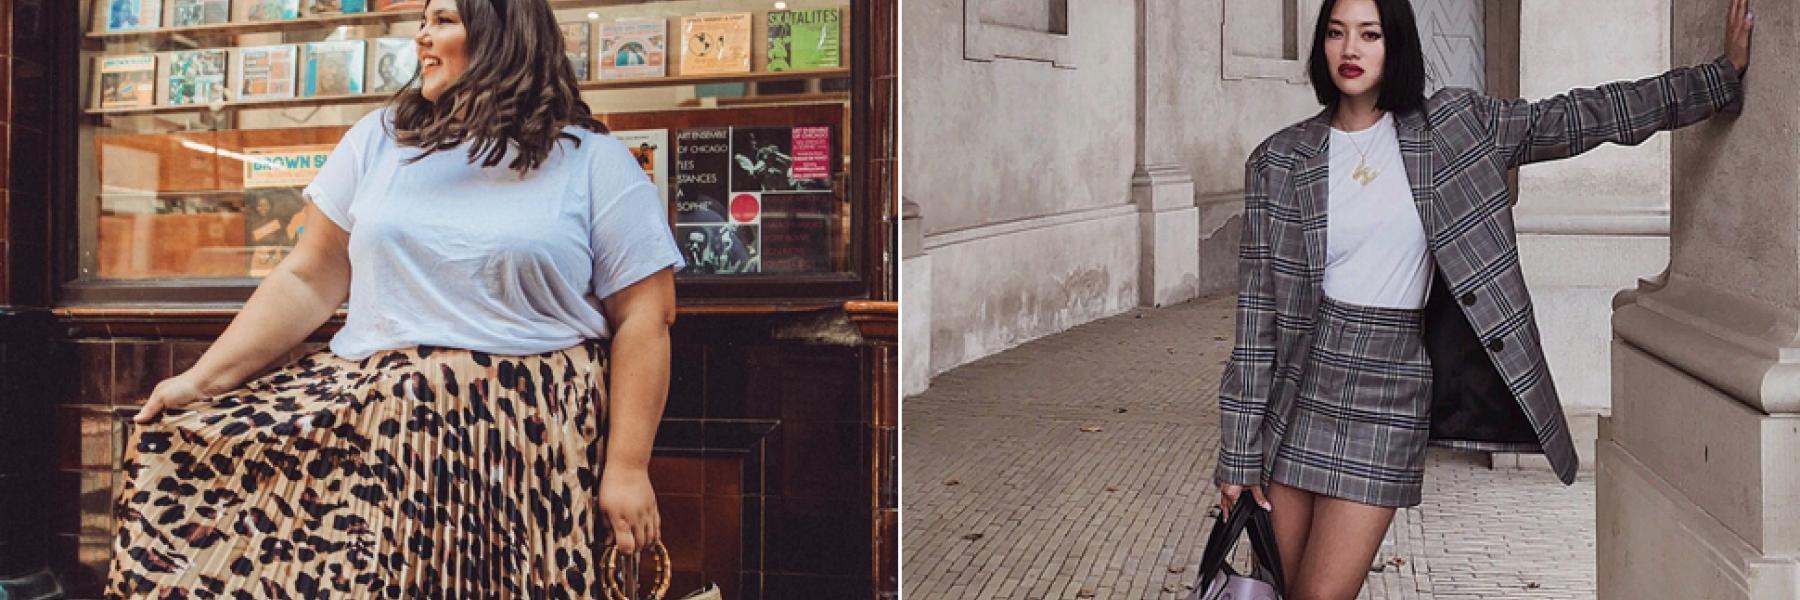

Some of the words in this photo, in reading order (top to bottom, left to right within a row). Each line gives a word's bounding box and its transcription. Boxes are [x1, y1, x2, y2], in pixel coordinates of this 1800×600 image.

[677, 131, 690, 139] ART
[678, 145, 688, 153] OF
[690, 144, 728, 153] CHICAGO
[254, 155, 310, 170] BROWN
[677, 173, 717, 183] STANCES
